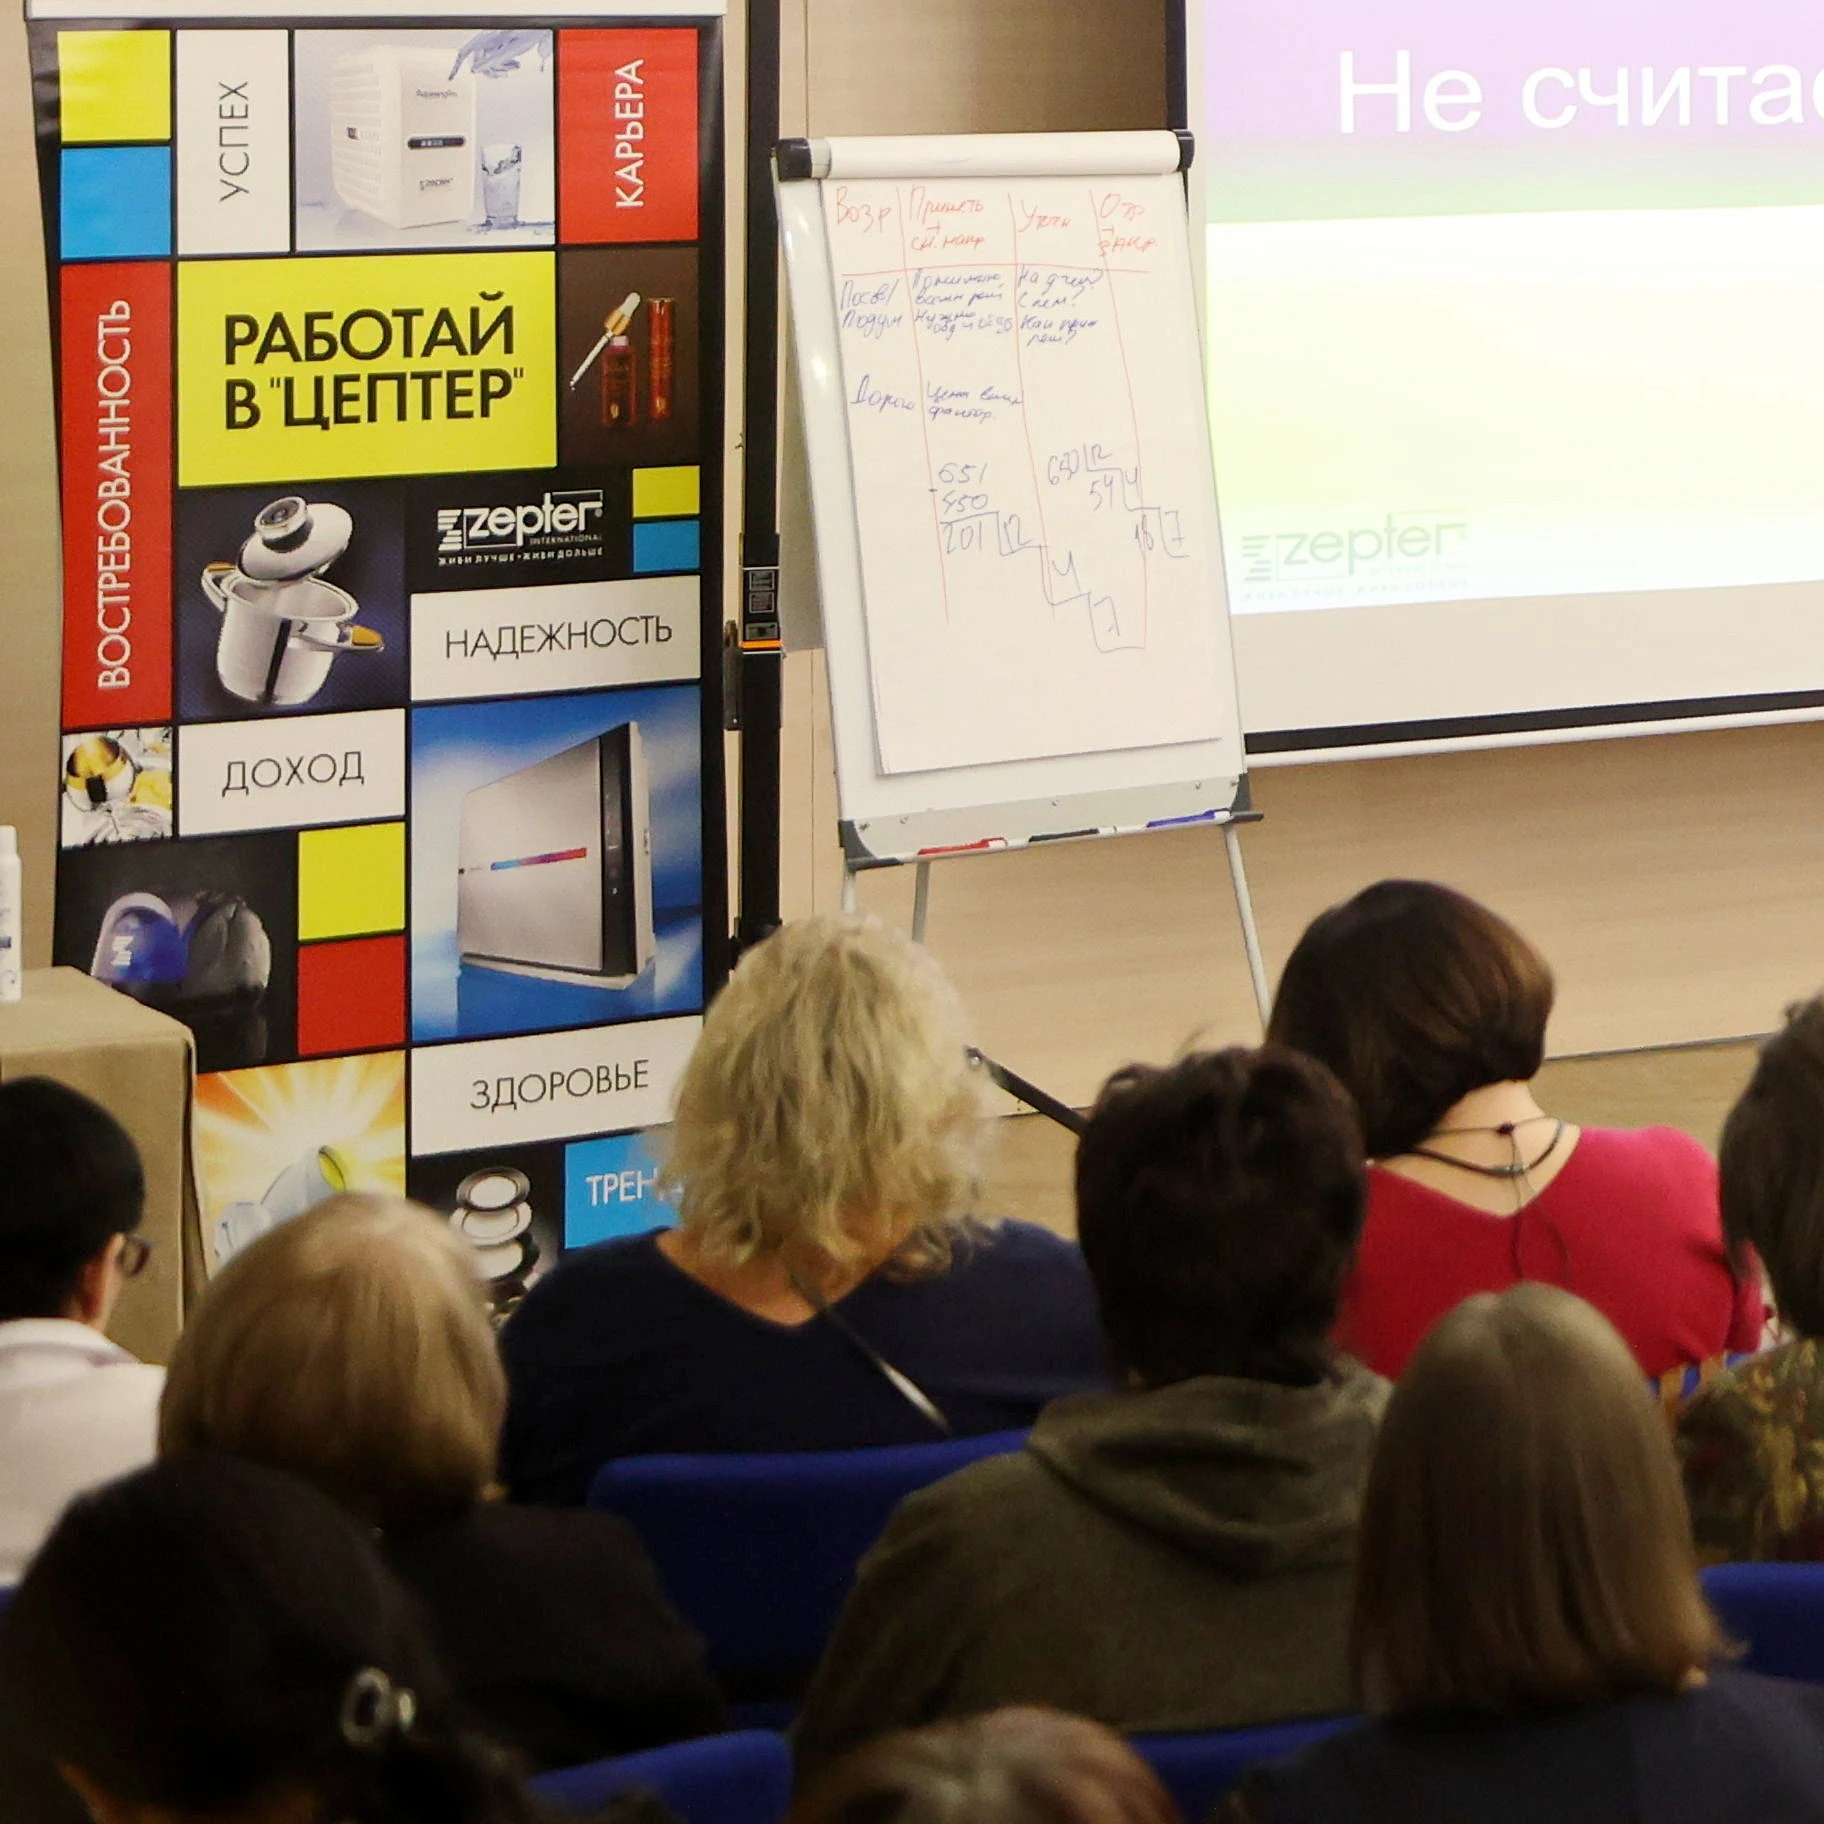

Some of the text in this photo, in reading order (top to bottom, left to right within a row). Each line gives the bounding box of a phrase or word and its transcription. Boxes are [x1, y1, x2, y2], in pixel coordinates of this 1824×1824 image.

[1339, 48, 1484, 134] Не
[219, 80, 250, 202] УСПЕХ
[615, 59, 645, 208] КАРЬЕРА
[224, 290, 515, 366] РАБОТАЙ
[225, 379, 260, 430] В
[97, 298, 132, 689] ВОСТРЕБОВАННОСТЬ
[463, 490, 603, 547] zepter
[1275, 512, 1467, 577] zepter
[445, 615, 673, 662] НАДЕЖНОСТЬ
[222, 751, 365, 797] ДОХОД
[470, 1060, 650, 1115] ЗДОРОВЬЕ
[585, 1167, 682, 1207] ТРЕН
